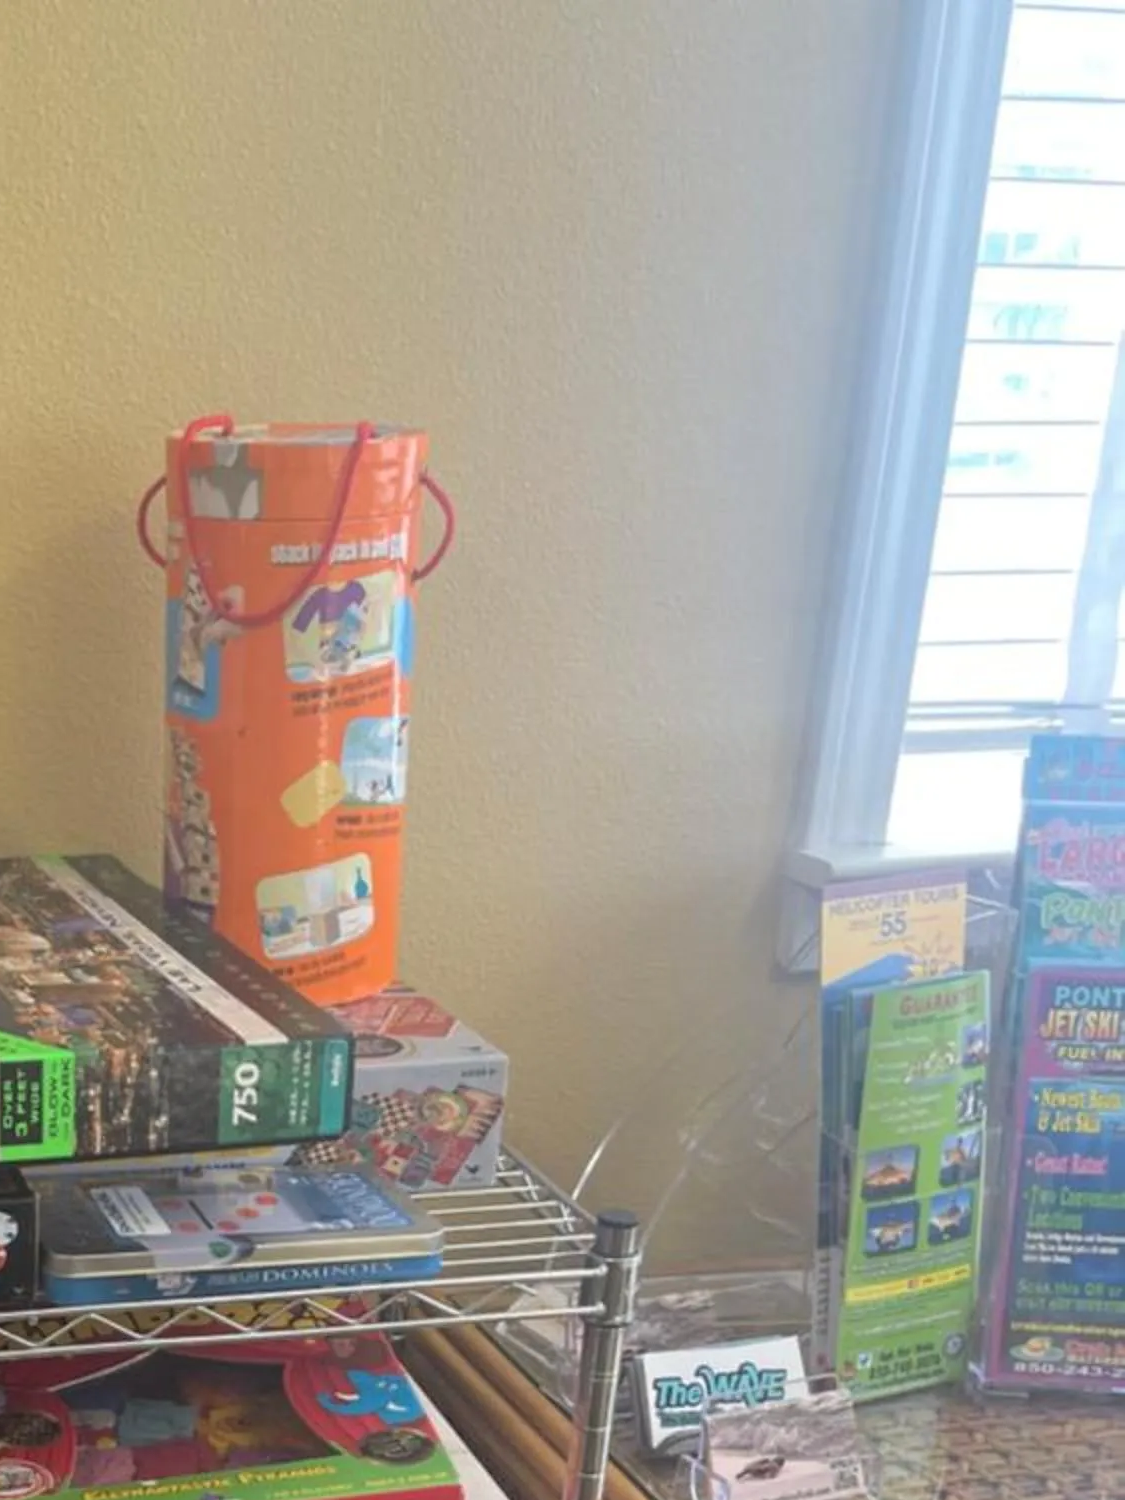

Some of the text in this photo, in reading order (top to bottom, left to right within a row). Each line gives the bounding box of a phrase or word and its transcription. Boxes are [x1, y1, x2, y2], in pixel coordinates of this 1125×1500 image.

[3, 1080, 14, 1130] OVER
[16, 1068, 28, 1114] FEET
[231, 1061, 261, 1127] 750
[652, 1360, 787, 1409] The WAVE
